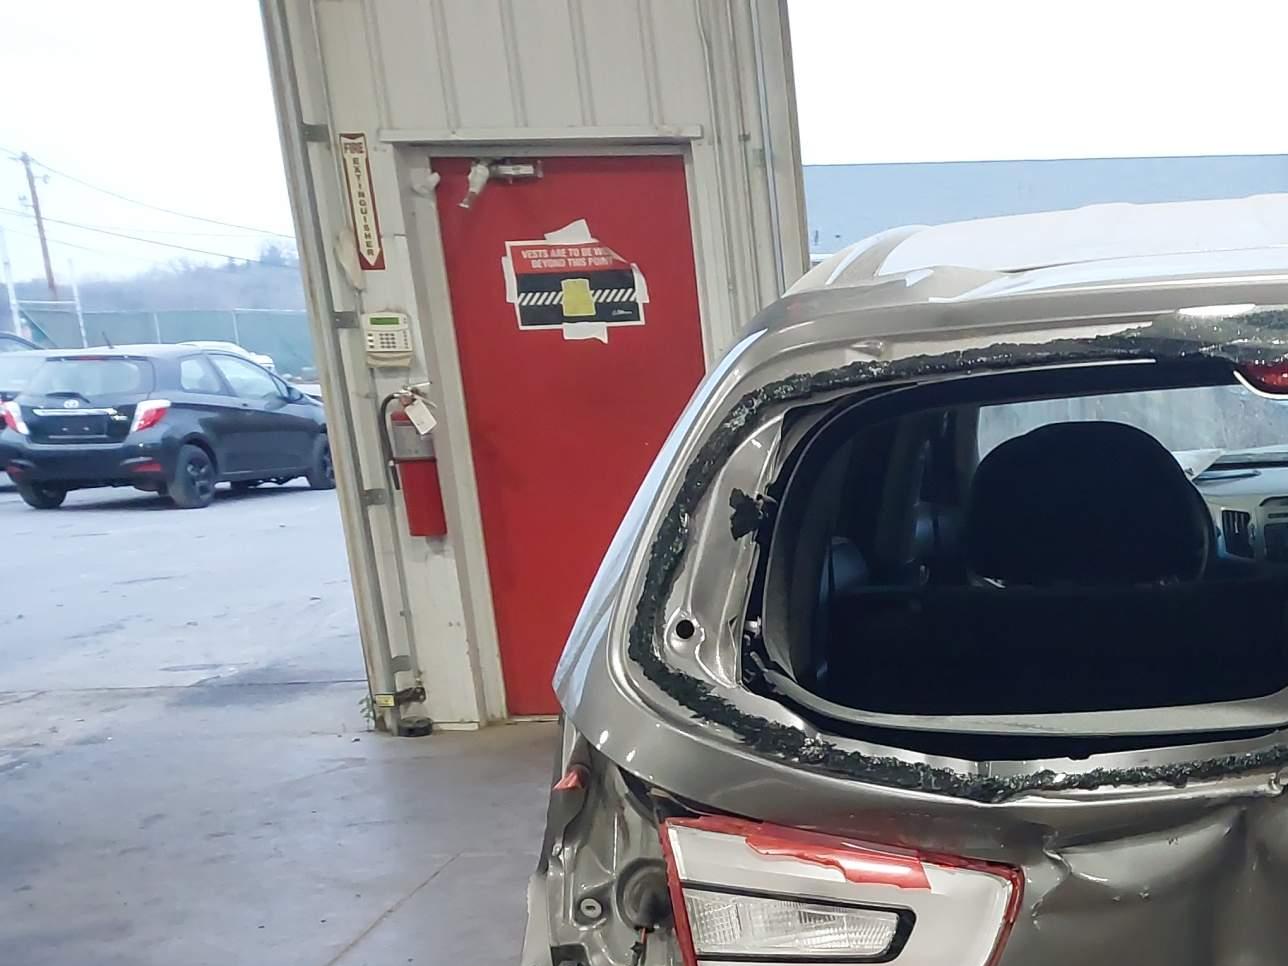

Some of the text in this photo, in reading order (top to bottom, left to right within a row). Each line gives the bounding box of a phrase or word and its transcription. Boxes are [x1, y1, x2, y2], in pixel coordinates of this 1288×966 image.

[344, 142, 364, 154] FIRE
[352, 157, 375, 256] EXTINGUISHER
[521, 249, 549, 259] VESTS
[550, 248, 568, 258] ARE
[568, 247, 580, 257] TO
[581, 247, 593, 257] BE
[531, 256, 613, 269] BEYOND THIS POINT
